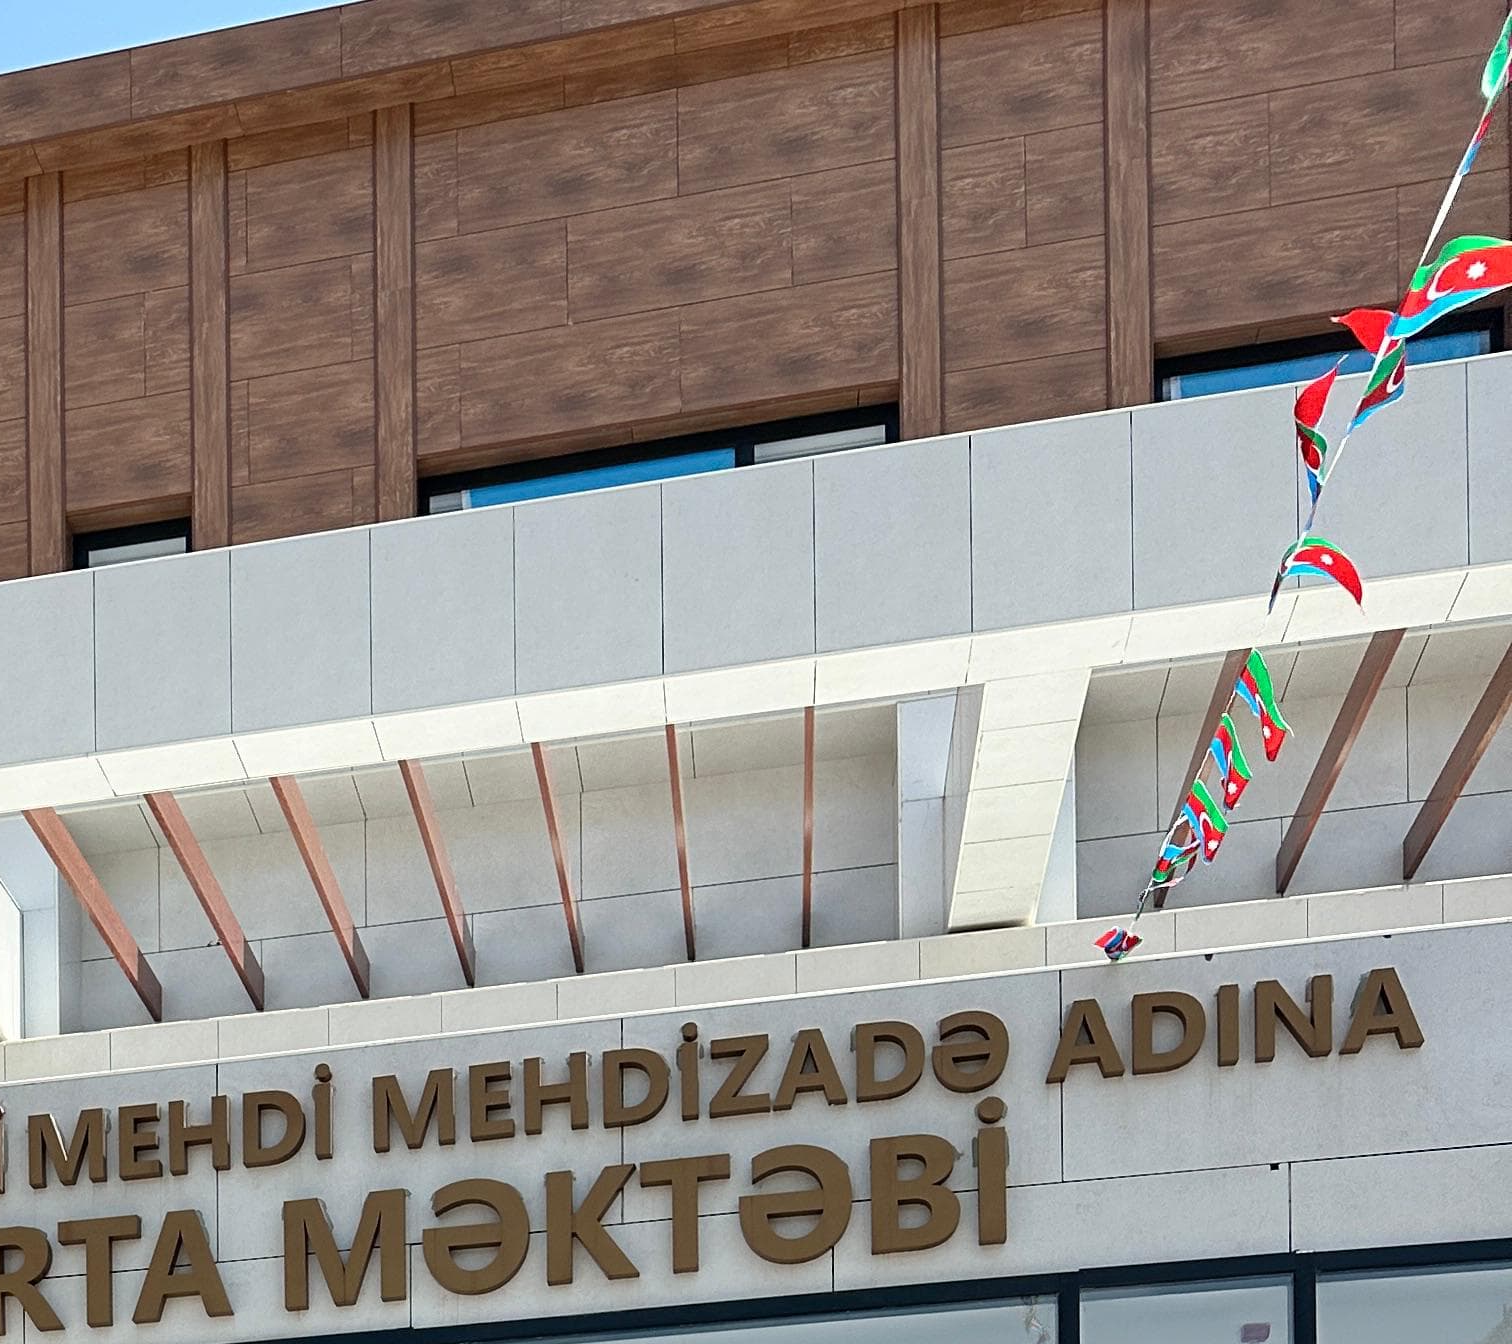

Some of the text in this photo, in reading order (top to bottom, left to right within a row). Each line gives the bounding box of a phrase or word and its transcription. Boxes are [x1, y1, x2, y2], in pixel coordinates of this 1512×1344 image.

[27, 1062, 334, 1189] MEHDİ
[372, 1010, 1010, 1153] MEHDİZADƏ
[1045, 967, 1425, 1084] ADINA
[283, 1096, 1008, 1312] MƏKTƏBİ
